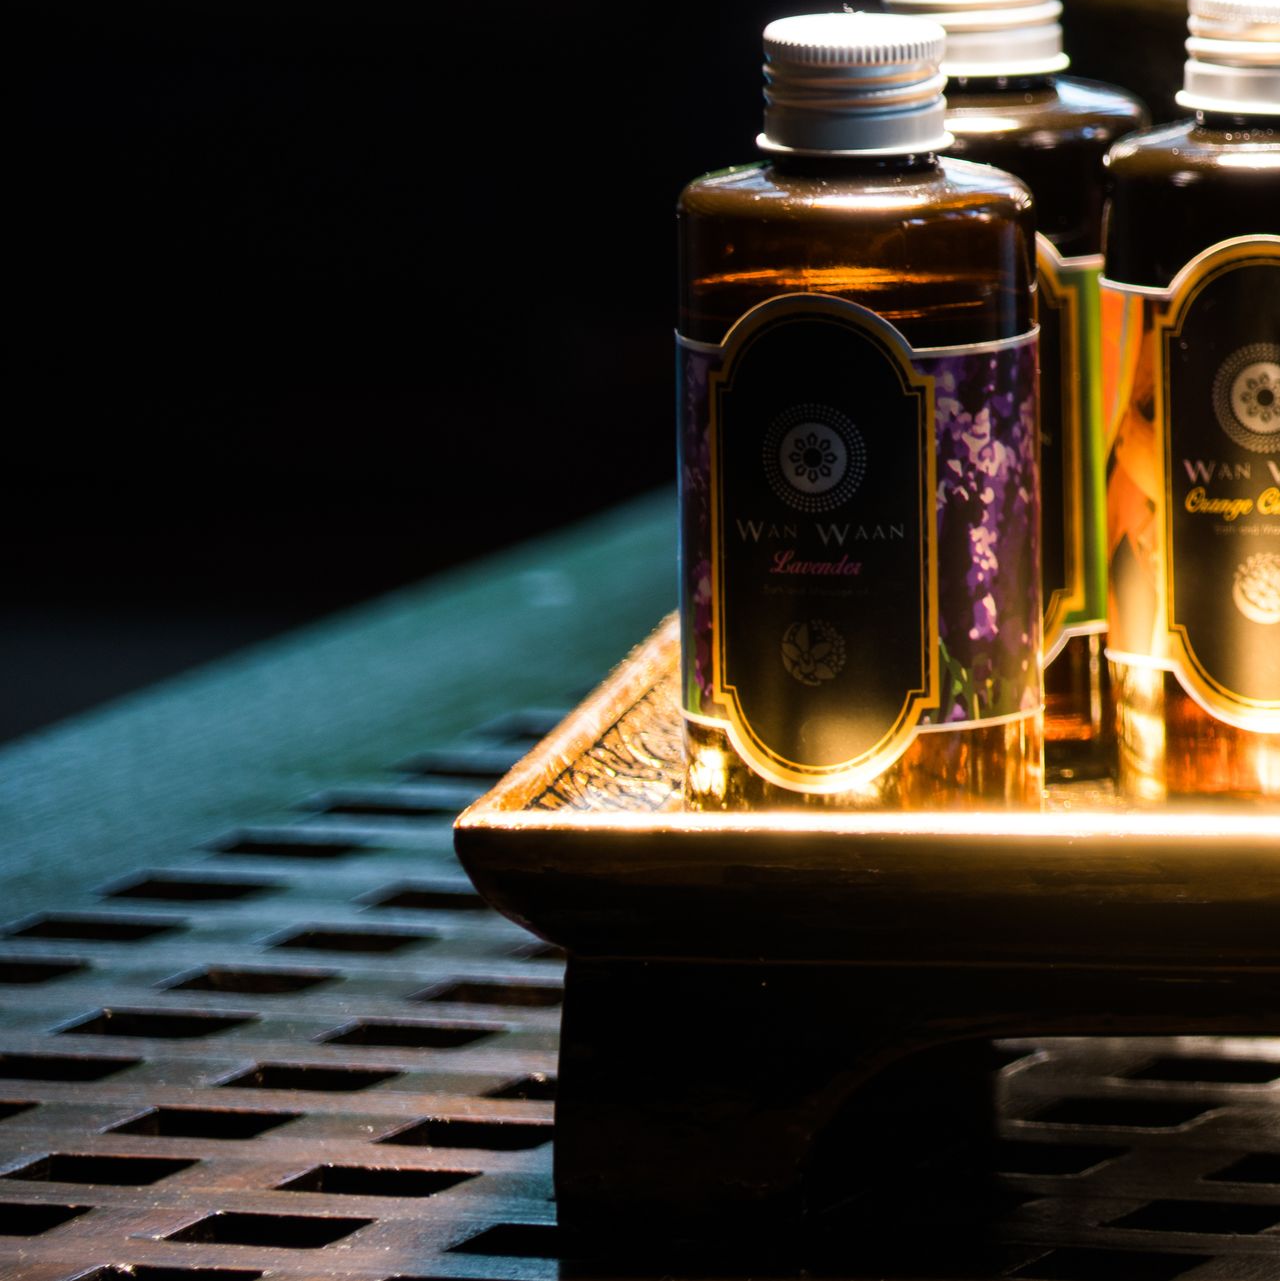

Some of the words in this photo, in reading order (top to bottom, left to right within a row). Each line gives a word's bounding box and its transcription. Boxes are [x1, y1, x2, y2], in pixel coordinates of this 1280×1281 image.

[1184, 459, 1252, 484] WAN
[1185, 486, 1254, 522] Orange
[736, 518, 797, 543] WAN
[815, 523, 905, 546] WAAN
[769, 549, 863, 576] Lavender
